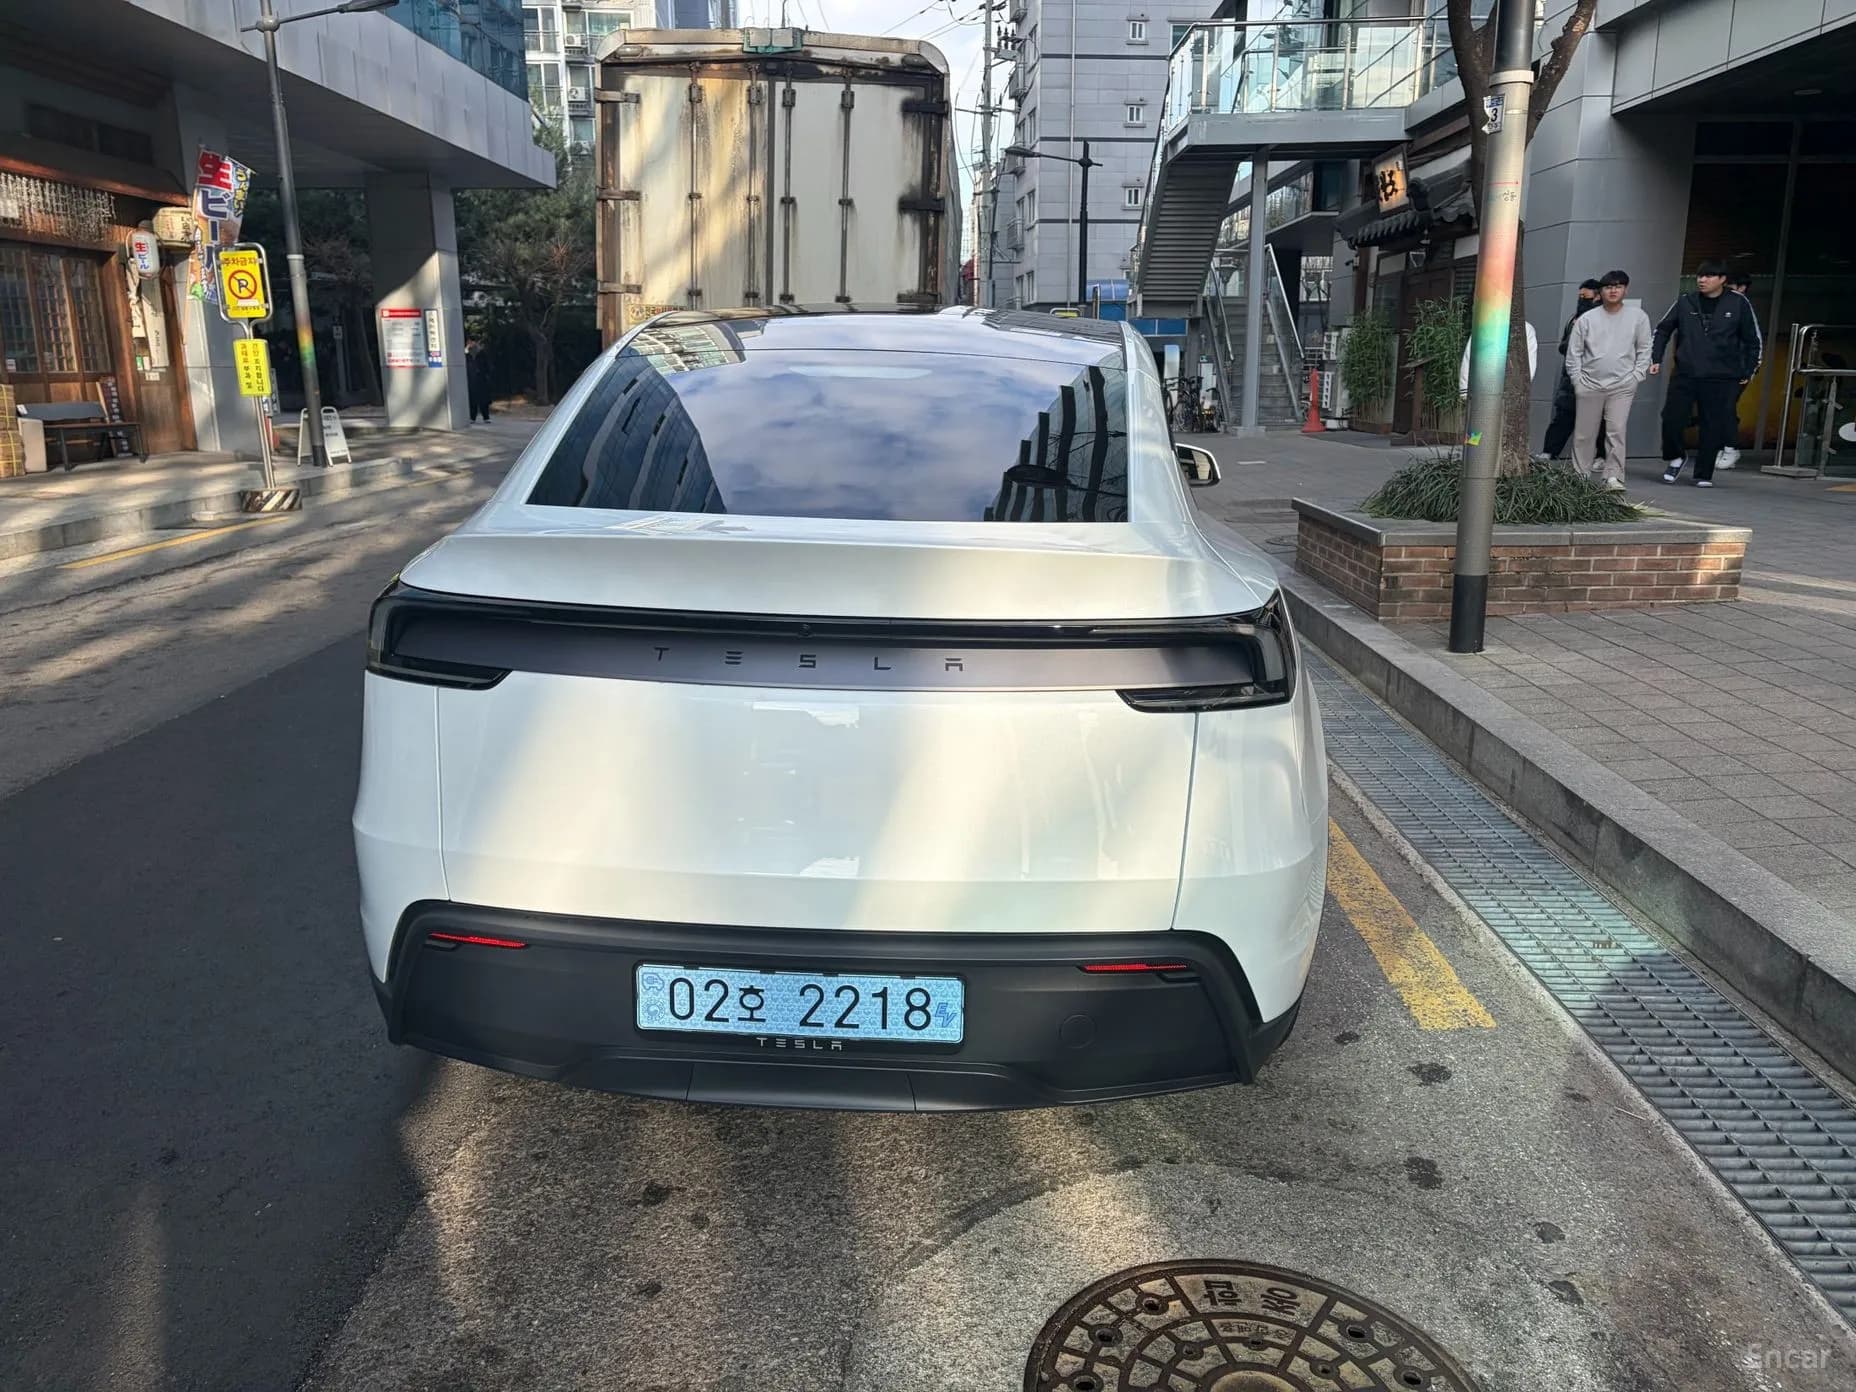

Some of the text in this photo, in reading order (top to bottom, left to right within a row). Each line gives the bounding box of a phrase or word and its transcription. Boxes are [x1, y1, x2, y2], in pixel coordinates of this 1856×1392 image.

[223, 256, 257, 267] 주차금지
[654, 647, 964, 672] TESLA
[668, 977, 932, 1031] 02호 2218
[934, 1001, 957, 1028] EV
[756, 1036, 843, 1050] TESLA
